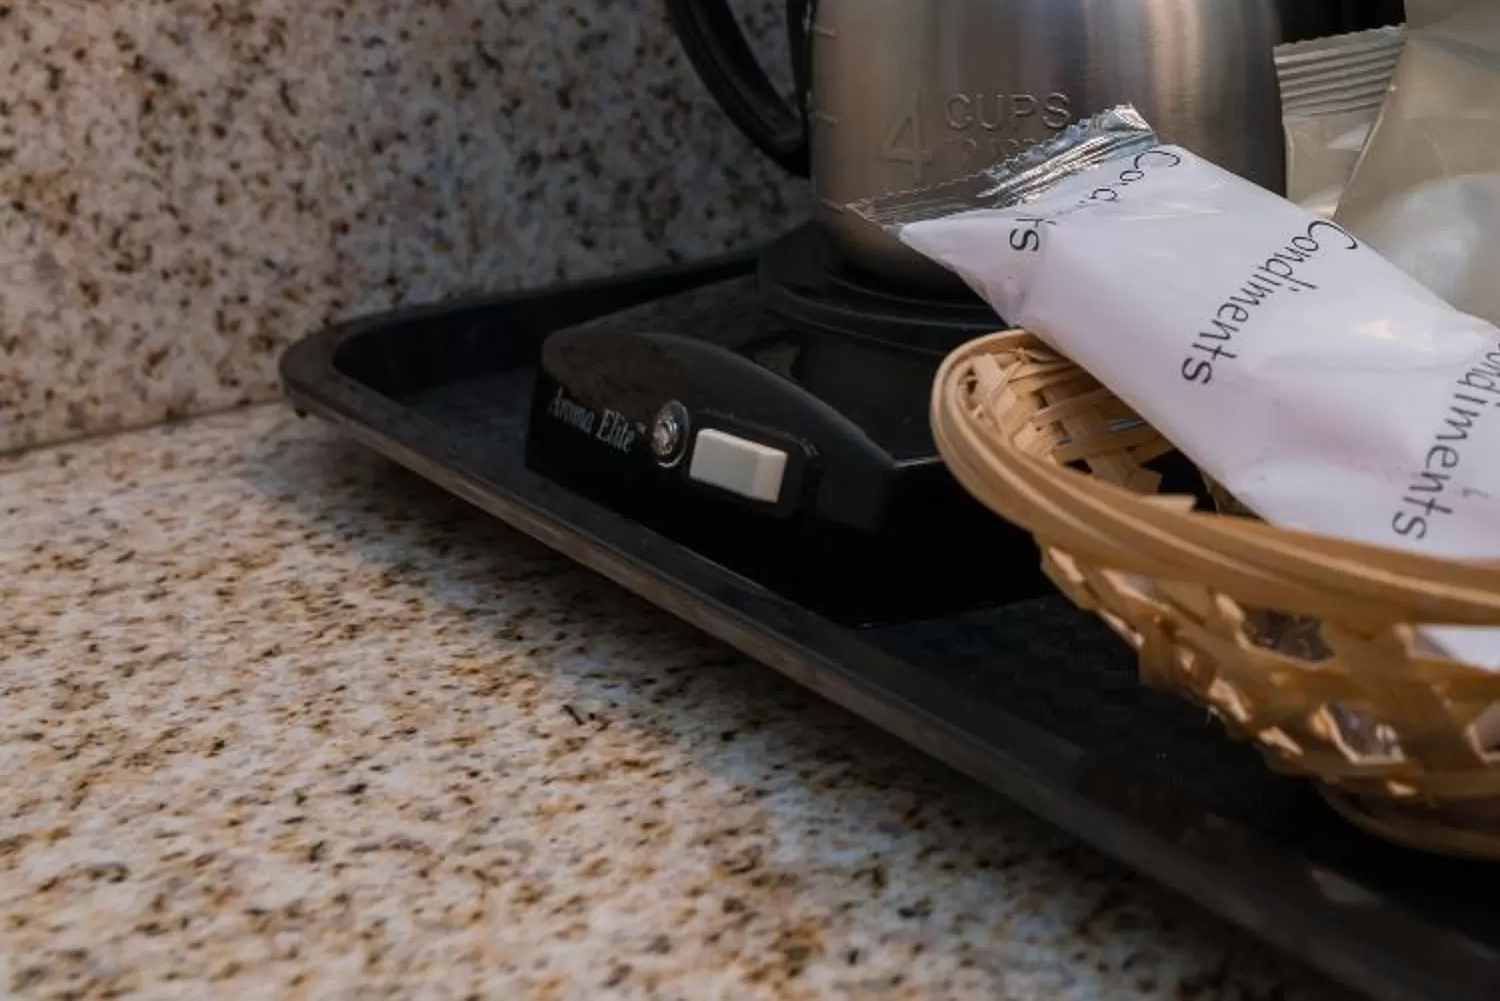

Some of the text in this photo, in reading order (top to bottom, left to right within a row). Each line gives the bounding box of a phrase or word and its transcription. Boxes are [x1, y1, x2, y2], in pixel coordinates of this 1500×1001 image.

[876, 90, 932, 181] 4
[944, 86, 1073, 131] CUPS
[1181, 219, 1359, 386] Condiments
